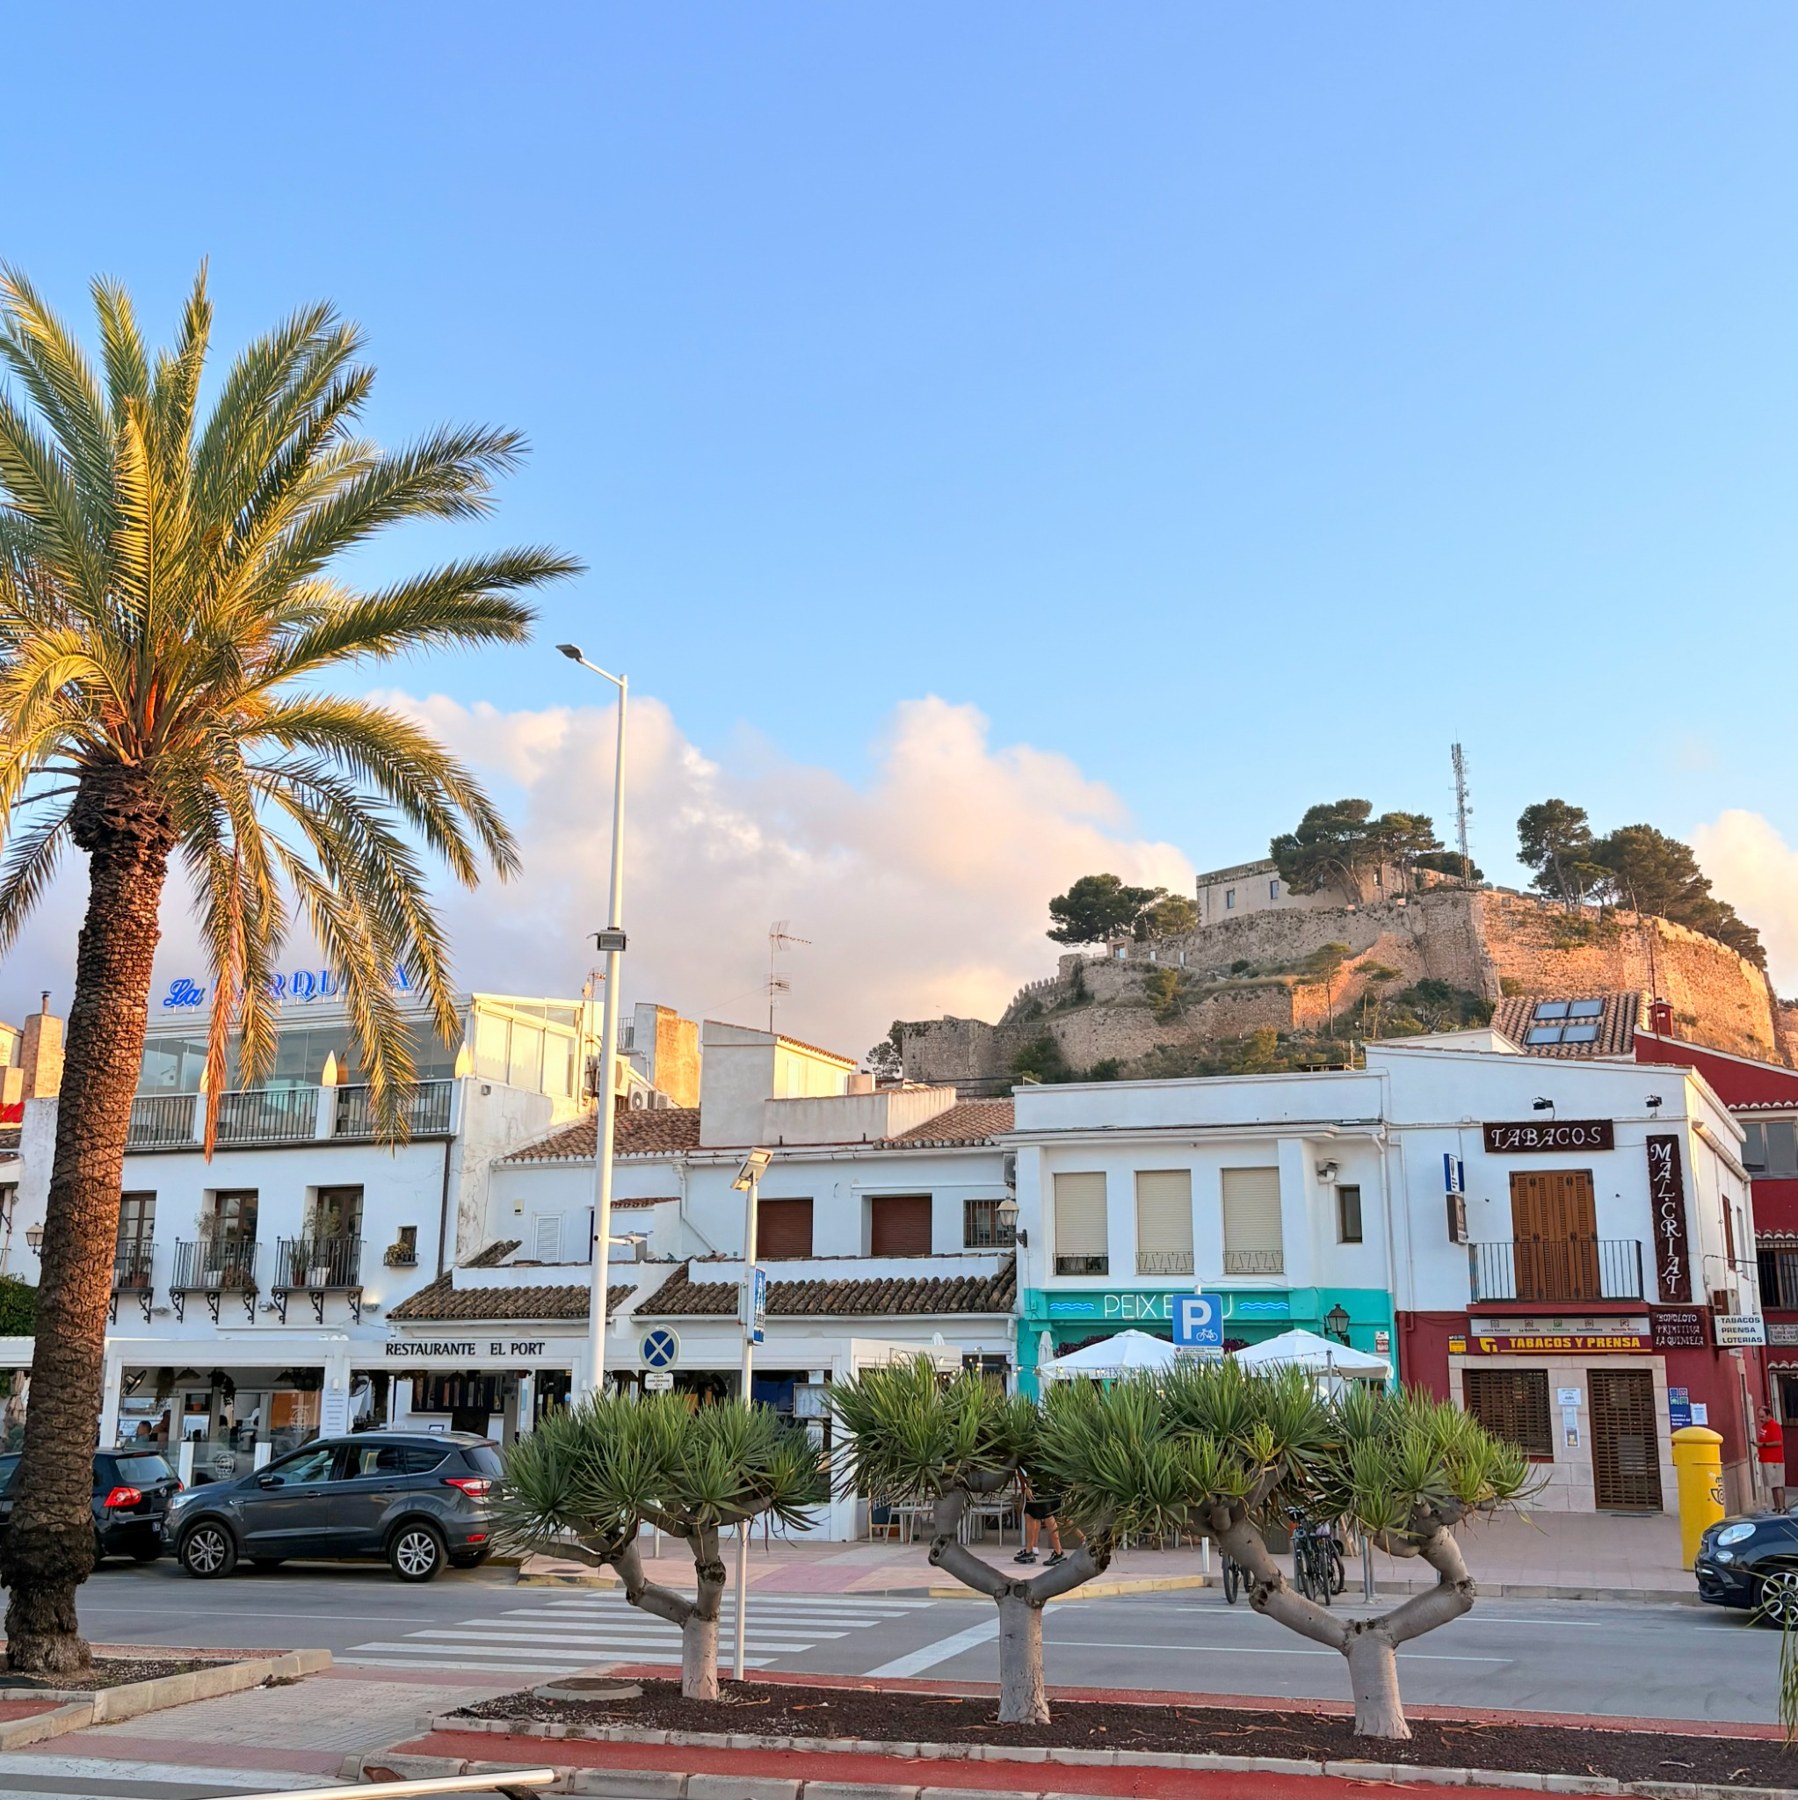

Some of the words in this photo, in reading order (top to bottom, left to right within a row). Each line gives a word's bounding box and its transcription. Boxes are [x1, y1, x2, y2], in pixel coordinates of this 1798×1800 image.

[163, 978, 203, 1007] La
[210, 963, 412, 1003] RQUA
[1490, 1126, 1602, 1149] TABACOS
[1103, 1294, 1157, 1319] PEIX
[1182, 1299, 1213, 1340] P
[1721, 1326, 1757, 1334] PRENSA
[385, 1342, 477, 1356] RESTAURANTE
[490, 1342, 507, 1356] EL
[510, 1342, 546, 1356] PORT
[1509, 1337, 1571, 1349] TABACOS
[1574, 1337, 1584, 1348] Y
[1587, 1336, 1641, 1348] PRENSA
[1722, 1336, 1763, 1344] LOTERIAS
